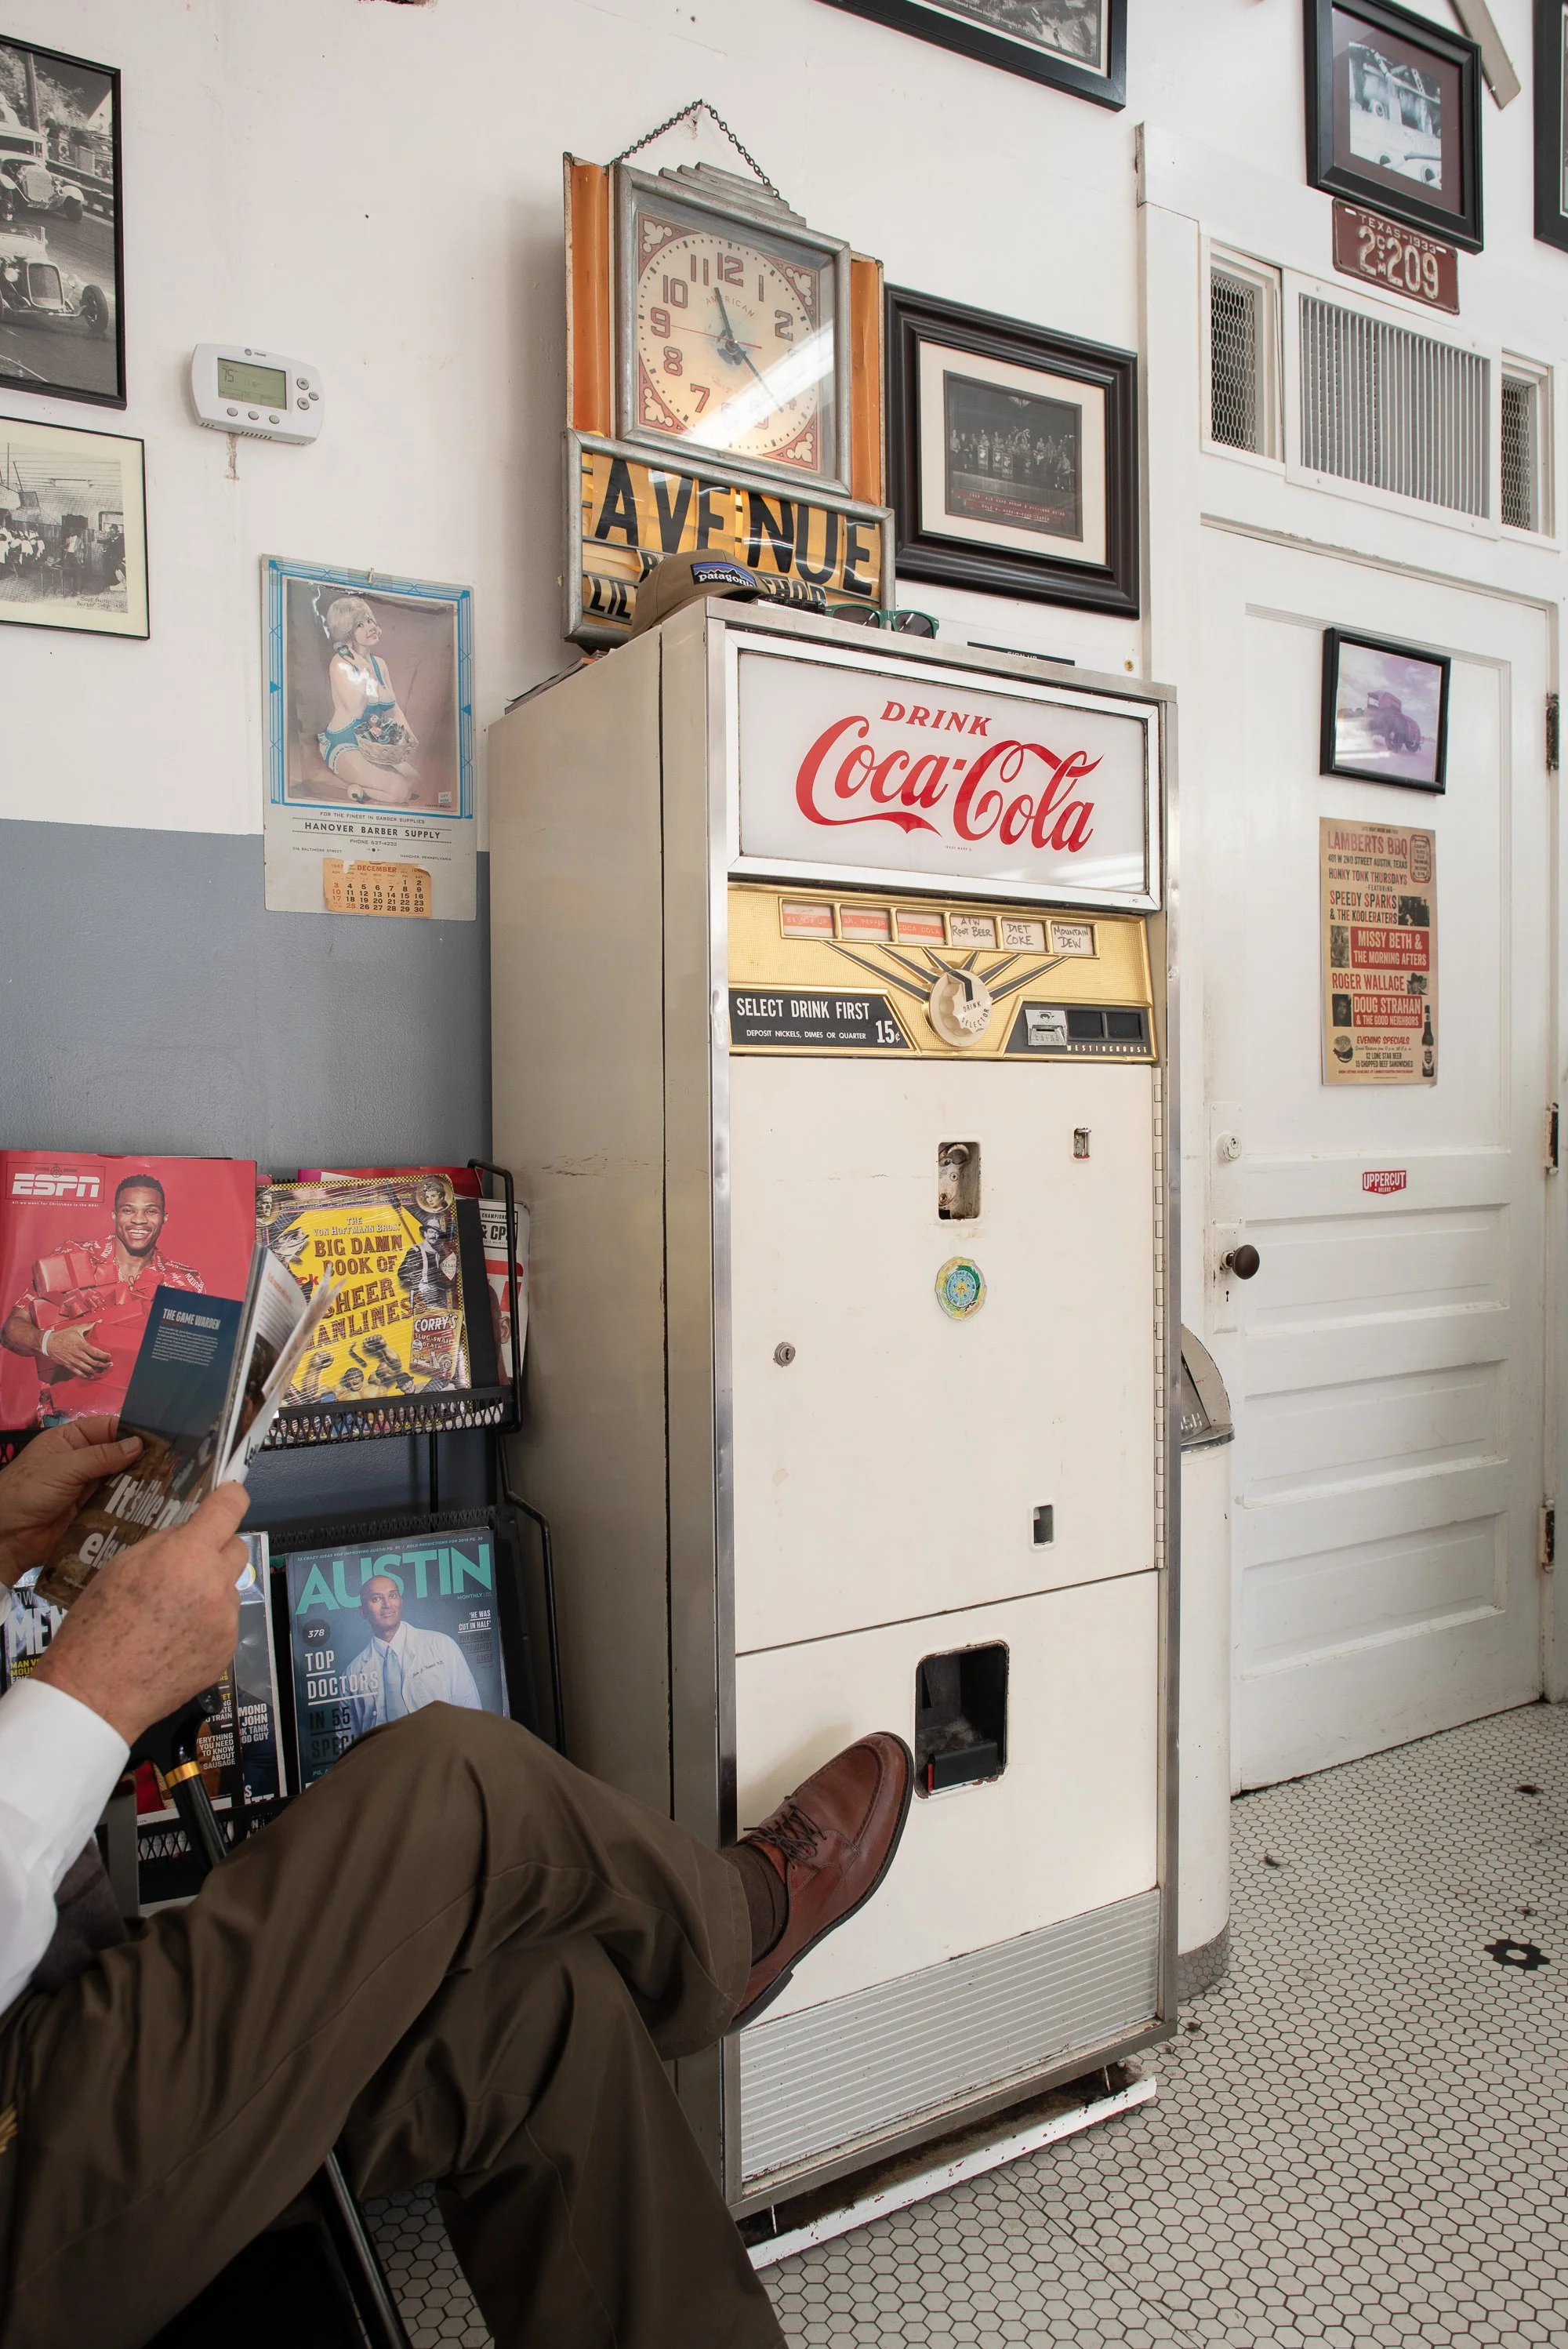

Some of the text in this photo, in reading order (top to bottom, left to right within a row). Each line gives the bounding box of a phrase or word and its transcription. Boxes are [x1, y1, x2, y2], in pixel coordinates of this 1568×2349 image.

[691, 254, 709, 286] 11
[717, 252, 743, 287] 12
[663, 274, 688, 309] 10
[759, 274, 764, 302] 1
[706, 294, 755, 318] AMERICAN
[651, 307, 670, 339] 9
[775, 310, 793, 342] 2
[664, 346, 682, 376] 8
[690, 383, 710, 413] 7
[595, 459, 875, 597] AVENUE
[880, 700, 993, 737] DRINK
[305, 822, 441, 839] HANOVER BARBER SUPPLY
[1328, 831, 1407, 859] LAMBERTS BBQ
[1355, 856, 1372, 866] STREET
[1374, 859, 1392, 868] AUSTIN,
[1393, 860, 1408, 869] TEXAS
[1329, 867, 1407, 885] HONKY TONK THURSDAYS
[1330, 891, 1397, 909] SPEEDY SPARKS
[1330, 909, 1397, 924] & THE KOOLERATERS
[1007, 924, 1031, 934] DIET
[1007, 935, 1033, 946] COKE
[1058, 937, 1081, 948] DEW
[1358, 931, 1422, 949] MISSY BETH &
[1353, 950, 1426, 967] THE MORNING AFTERS
[1332, 973, 1405, 991] ROGER WALLACE
[736, 997, 869, 1019] SELECT DRINK FIRST
[963, 1000, 981, 1012] DRINK
[1354, 997, 1421, 1015] DOUG STRAHAN
[961, 1008, 989, 1029] SELECTOR
[1356, 1015, 1419, 1026] & THE GOOD NEIGHBORS
[775, 1030, 802, 1039] NICKELS,
[12, 1174, 100, 1197] ESPN
[1364, 1172, 1405, 1189] UPPERCUT
[331, 1226, 374, 1235] HOFFMANN
[314, 1235, 403, 1257] BIG DAMN
[323, 1255, 398, 1277] BOOK OF
[163, 1309, 176, 1320] THE
[176, 1311, 195, 1325] GAME
[194, 1315, 221, 1330] WARDEN
[305, 1293, 426, 1350] ANLINESS
[415, 1314, 458, 1332] CORRY'S
[295, 1543, 492, 1615] AUSTIN
[307, 1628, 325, 1638] 378
[11, 1660, 29, 1668] MAN
[305, 1650, 335, 1672] TOP
[308, 1671, 379, 1700] DOCTORS
[212, 1712, 232, 1722] TRAIN
[242, 1713, 267, 1726] JOHN
[310, 1707, 350, 1730] IN 55
[249, 1724, 268, 1734] TANK
[253, 1732, 269, 1741] GUY
[199, 1741, 214, 1751] YOU
[212, 1745, 234, 1755] KNOW
[204, 1758, 235, 1770] SAUSAGE
[212, 1752, 235, 1762] ABOUT
